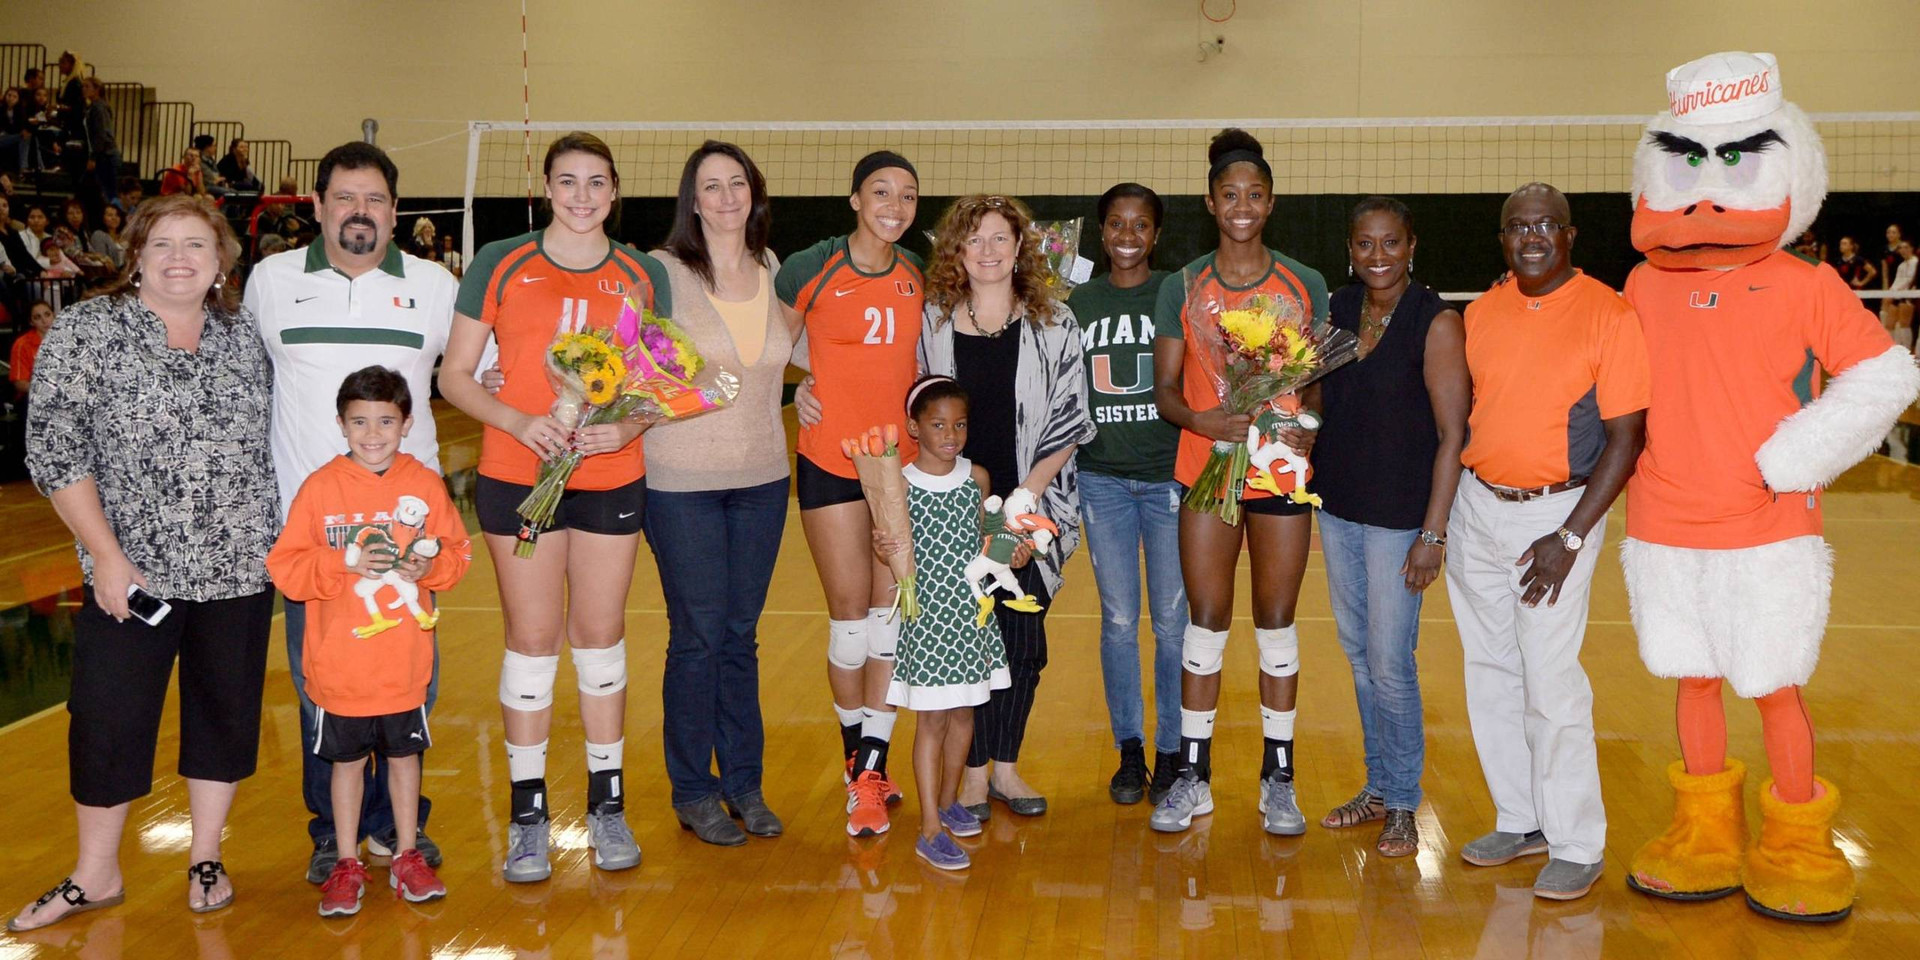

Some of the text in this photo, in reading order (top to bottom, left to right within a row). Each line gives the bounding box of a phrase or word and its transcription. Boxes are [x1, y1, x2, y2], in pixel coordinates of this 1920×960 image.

[1669, 70, 1770, 117] Hurricanes
[894, 281, 915, 296] U
[1689, 291, 1719, 308] U
[863, 306, 895, 345] 21
[1080, 314, 1155, 352] MIAM
[1095, 403, 1159, 423] SISTER
[323, 511, 393, 525] MIA
